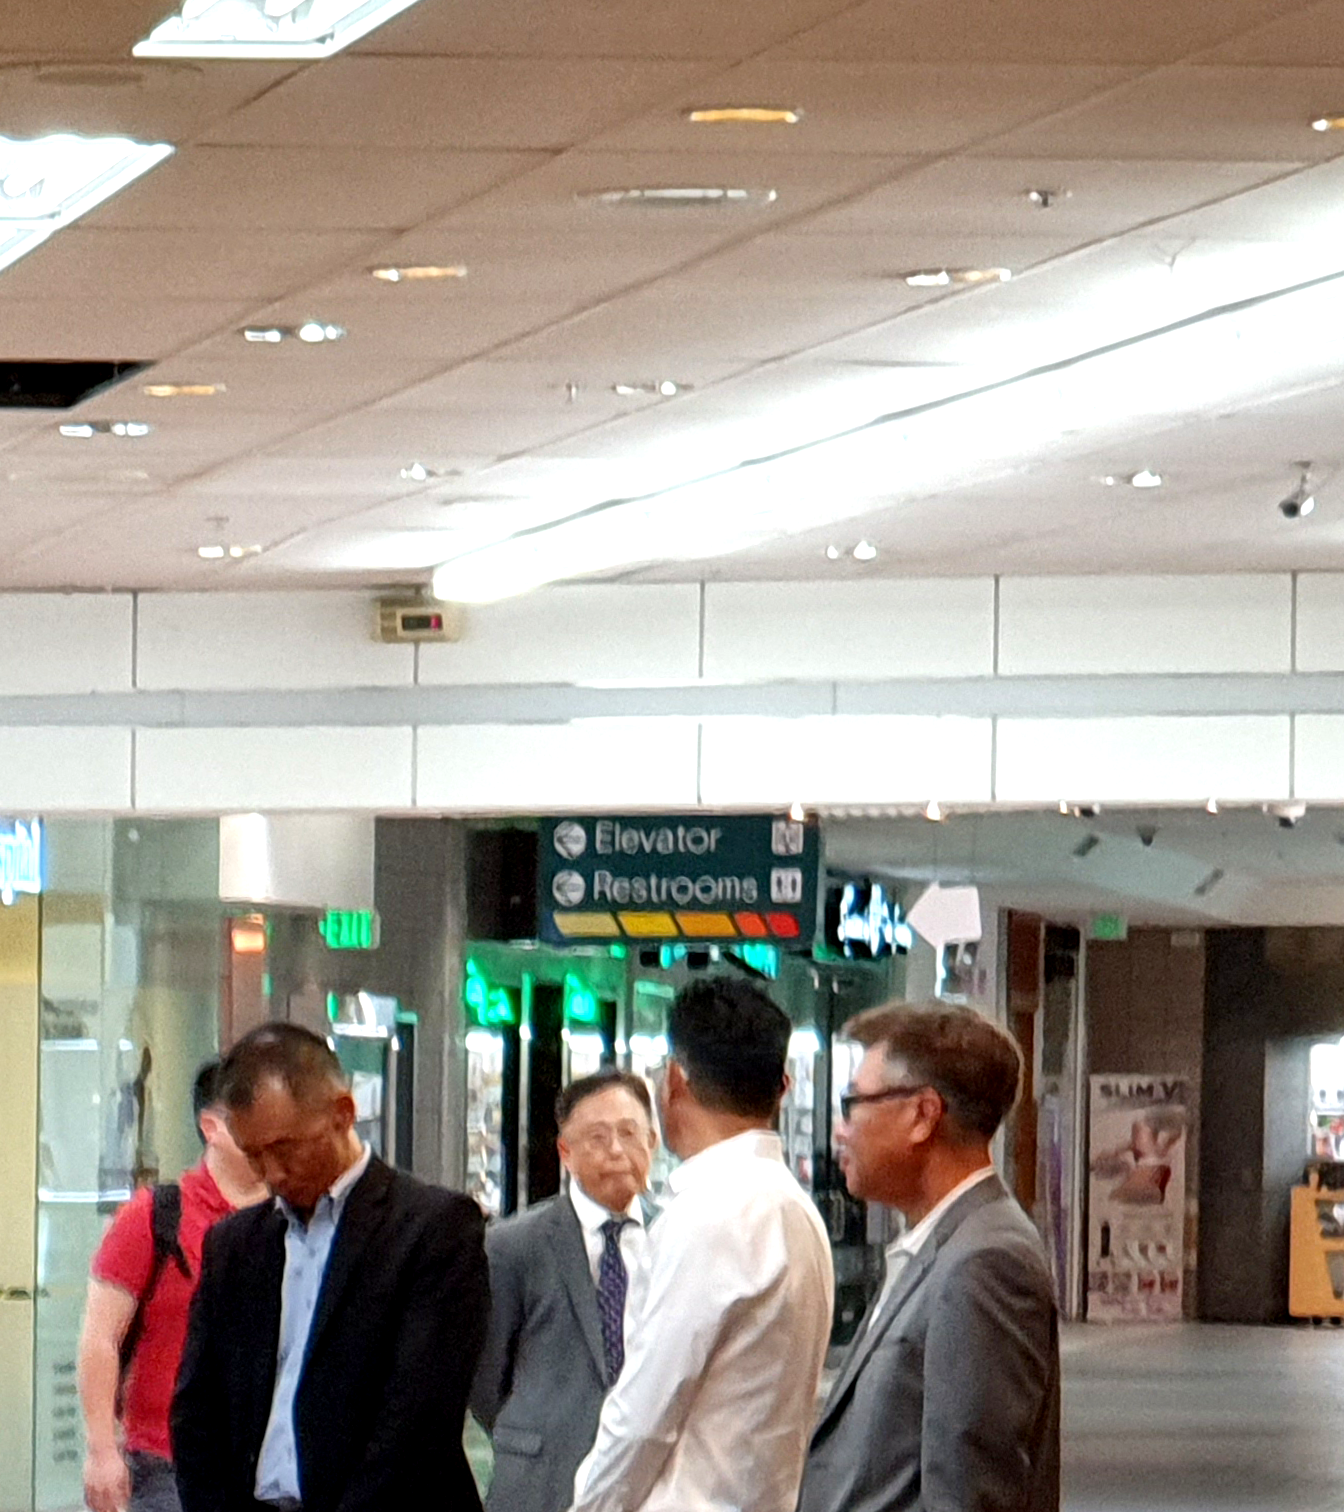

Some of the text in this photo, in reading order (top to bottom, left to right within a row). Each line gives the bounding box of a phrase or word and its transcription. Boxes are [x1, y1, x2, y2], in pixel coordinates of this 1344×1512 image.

[594, 820, 723, 855] Elevator
[593, 870, 759, 905] Restrooms
[325, 909, 371, 949] EXIT
[1099, 1082, 1155, 1100] SLIM
